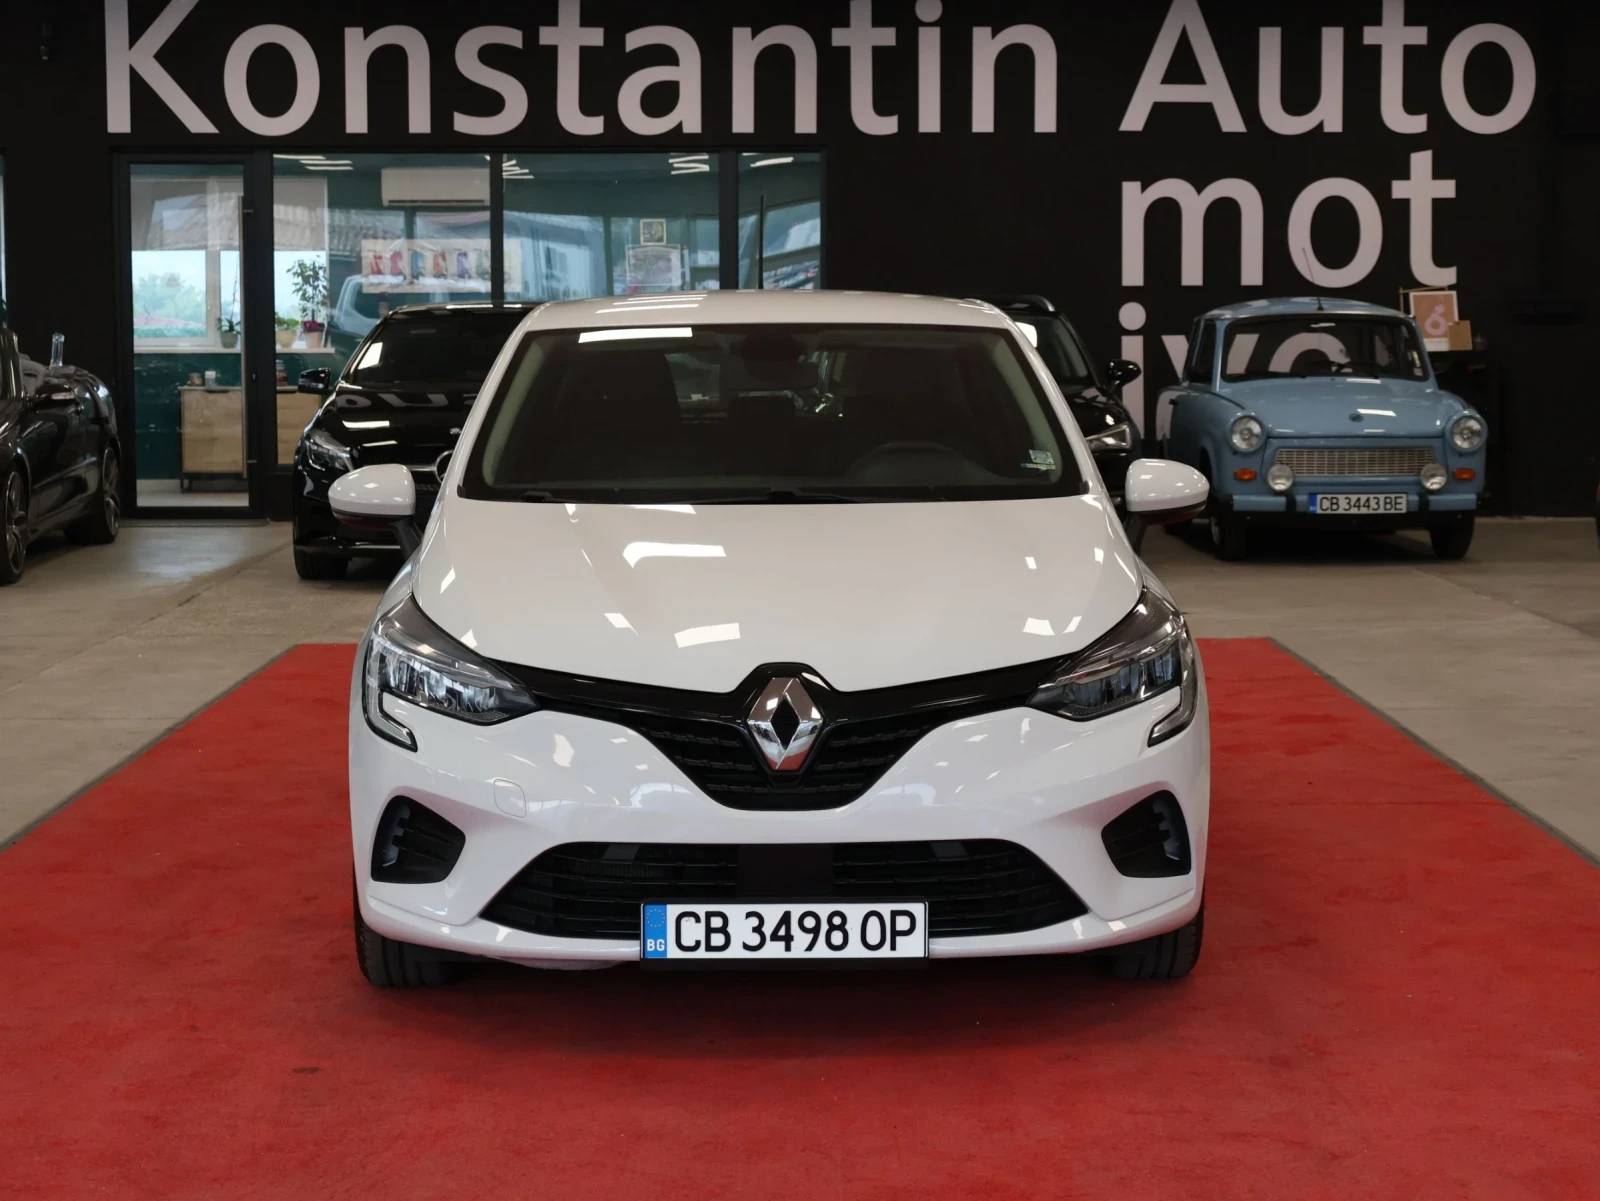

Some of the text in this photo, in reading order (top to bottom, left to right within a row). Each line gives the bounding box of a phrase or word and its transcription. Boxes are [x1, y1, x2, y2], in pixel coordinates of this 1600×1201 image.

[105, 0, 1535, 136] Konstantin Auto
[1122, 150, 1457, 287] mot
[1319, 496, 1340, 512] CB
[1343, 496, 1381, 512] 3443
[1383, 496, 1404, 511] BE
[646, 938, 665, 952] BG
[674, 909, 917, 953] CB 3498 OP
